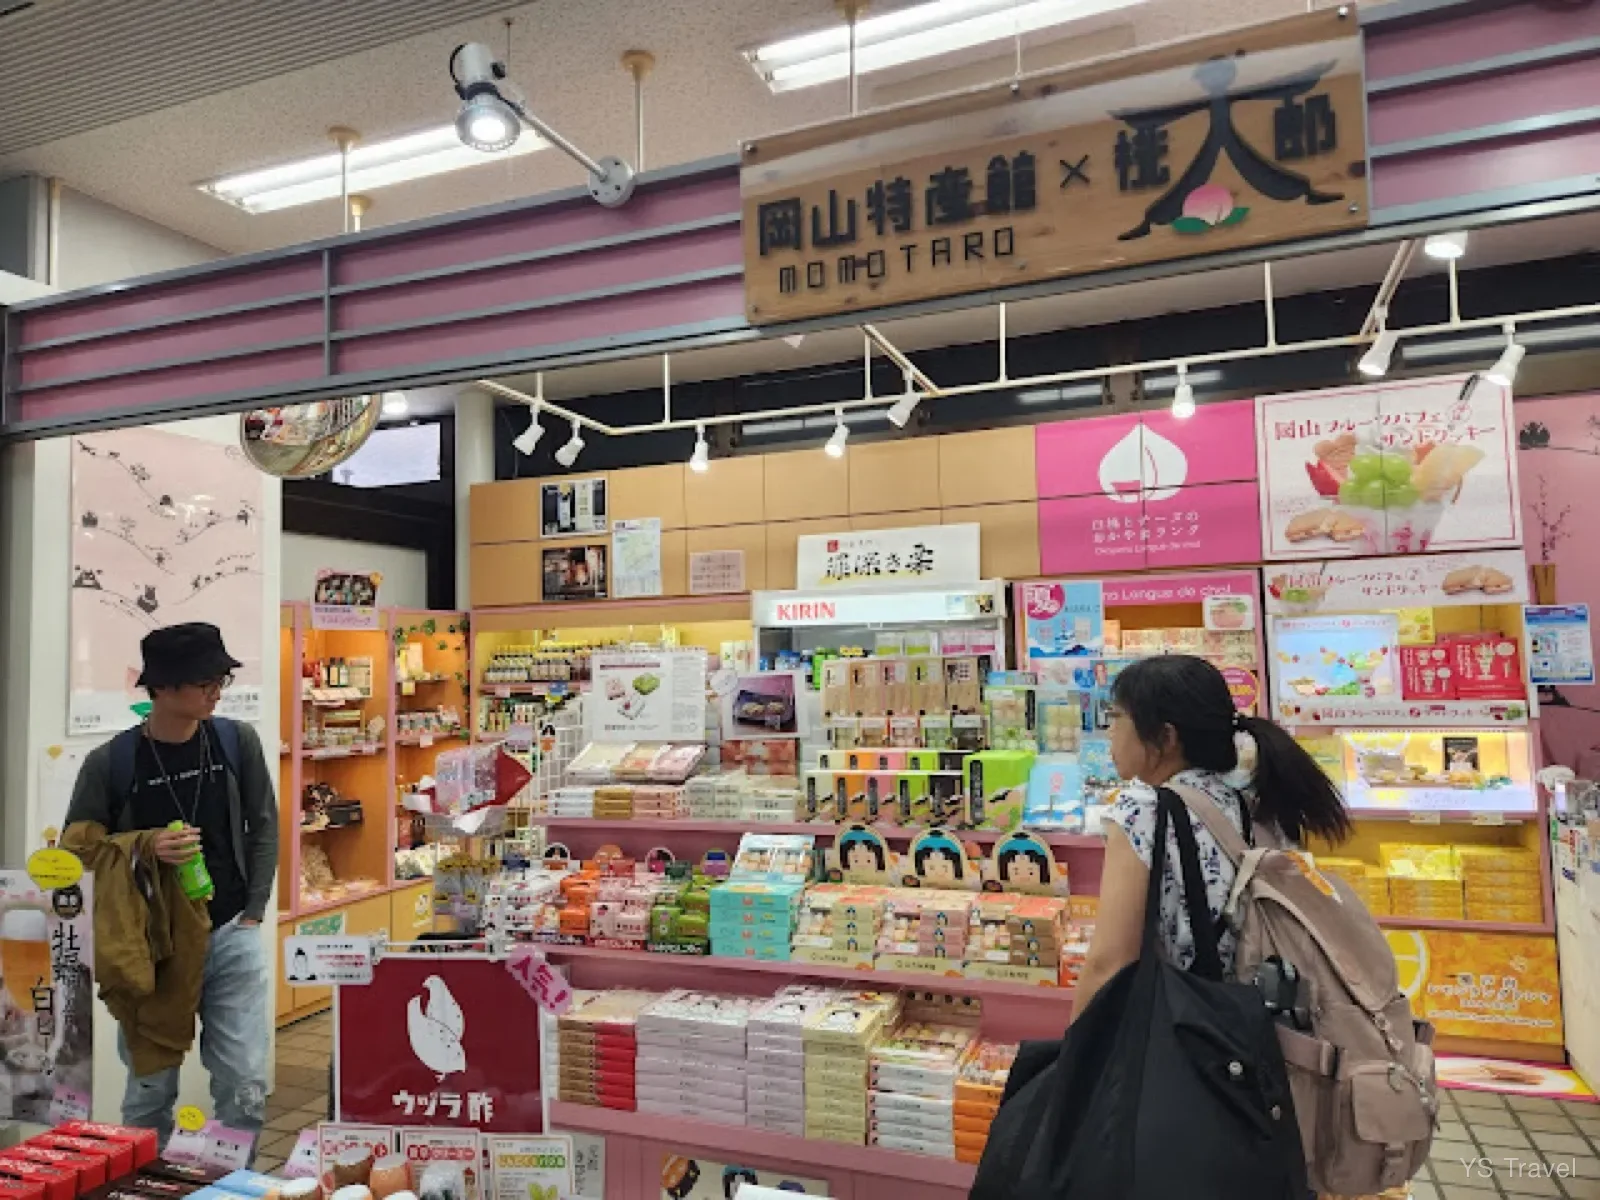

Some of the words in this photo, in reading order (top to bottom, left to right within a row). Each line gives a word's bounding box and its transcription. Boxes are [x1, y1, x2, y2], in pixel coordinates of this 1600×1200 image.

[758, 150, 1036, 256] 岡山特産館
[777, 601, 836, 620] KIRIN
